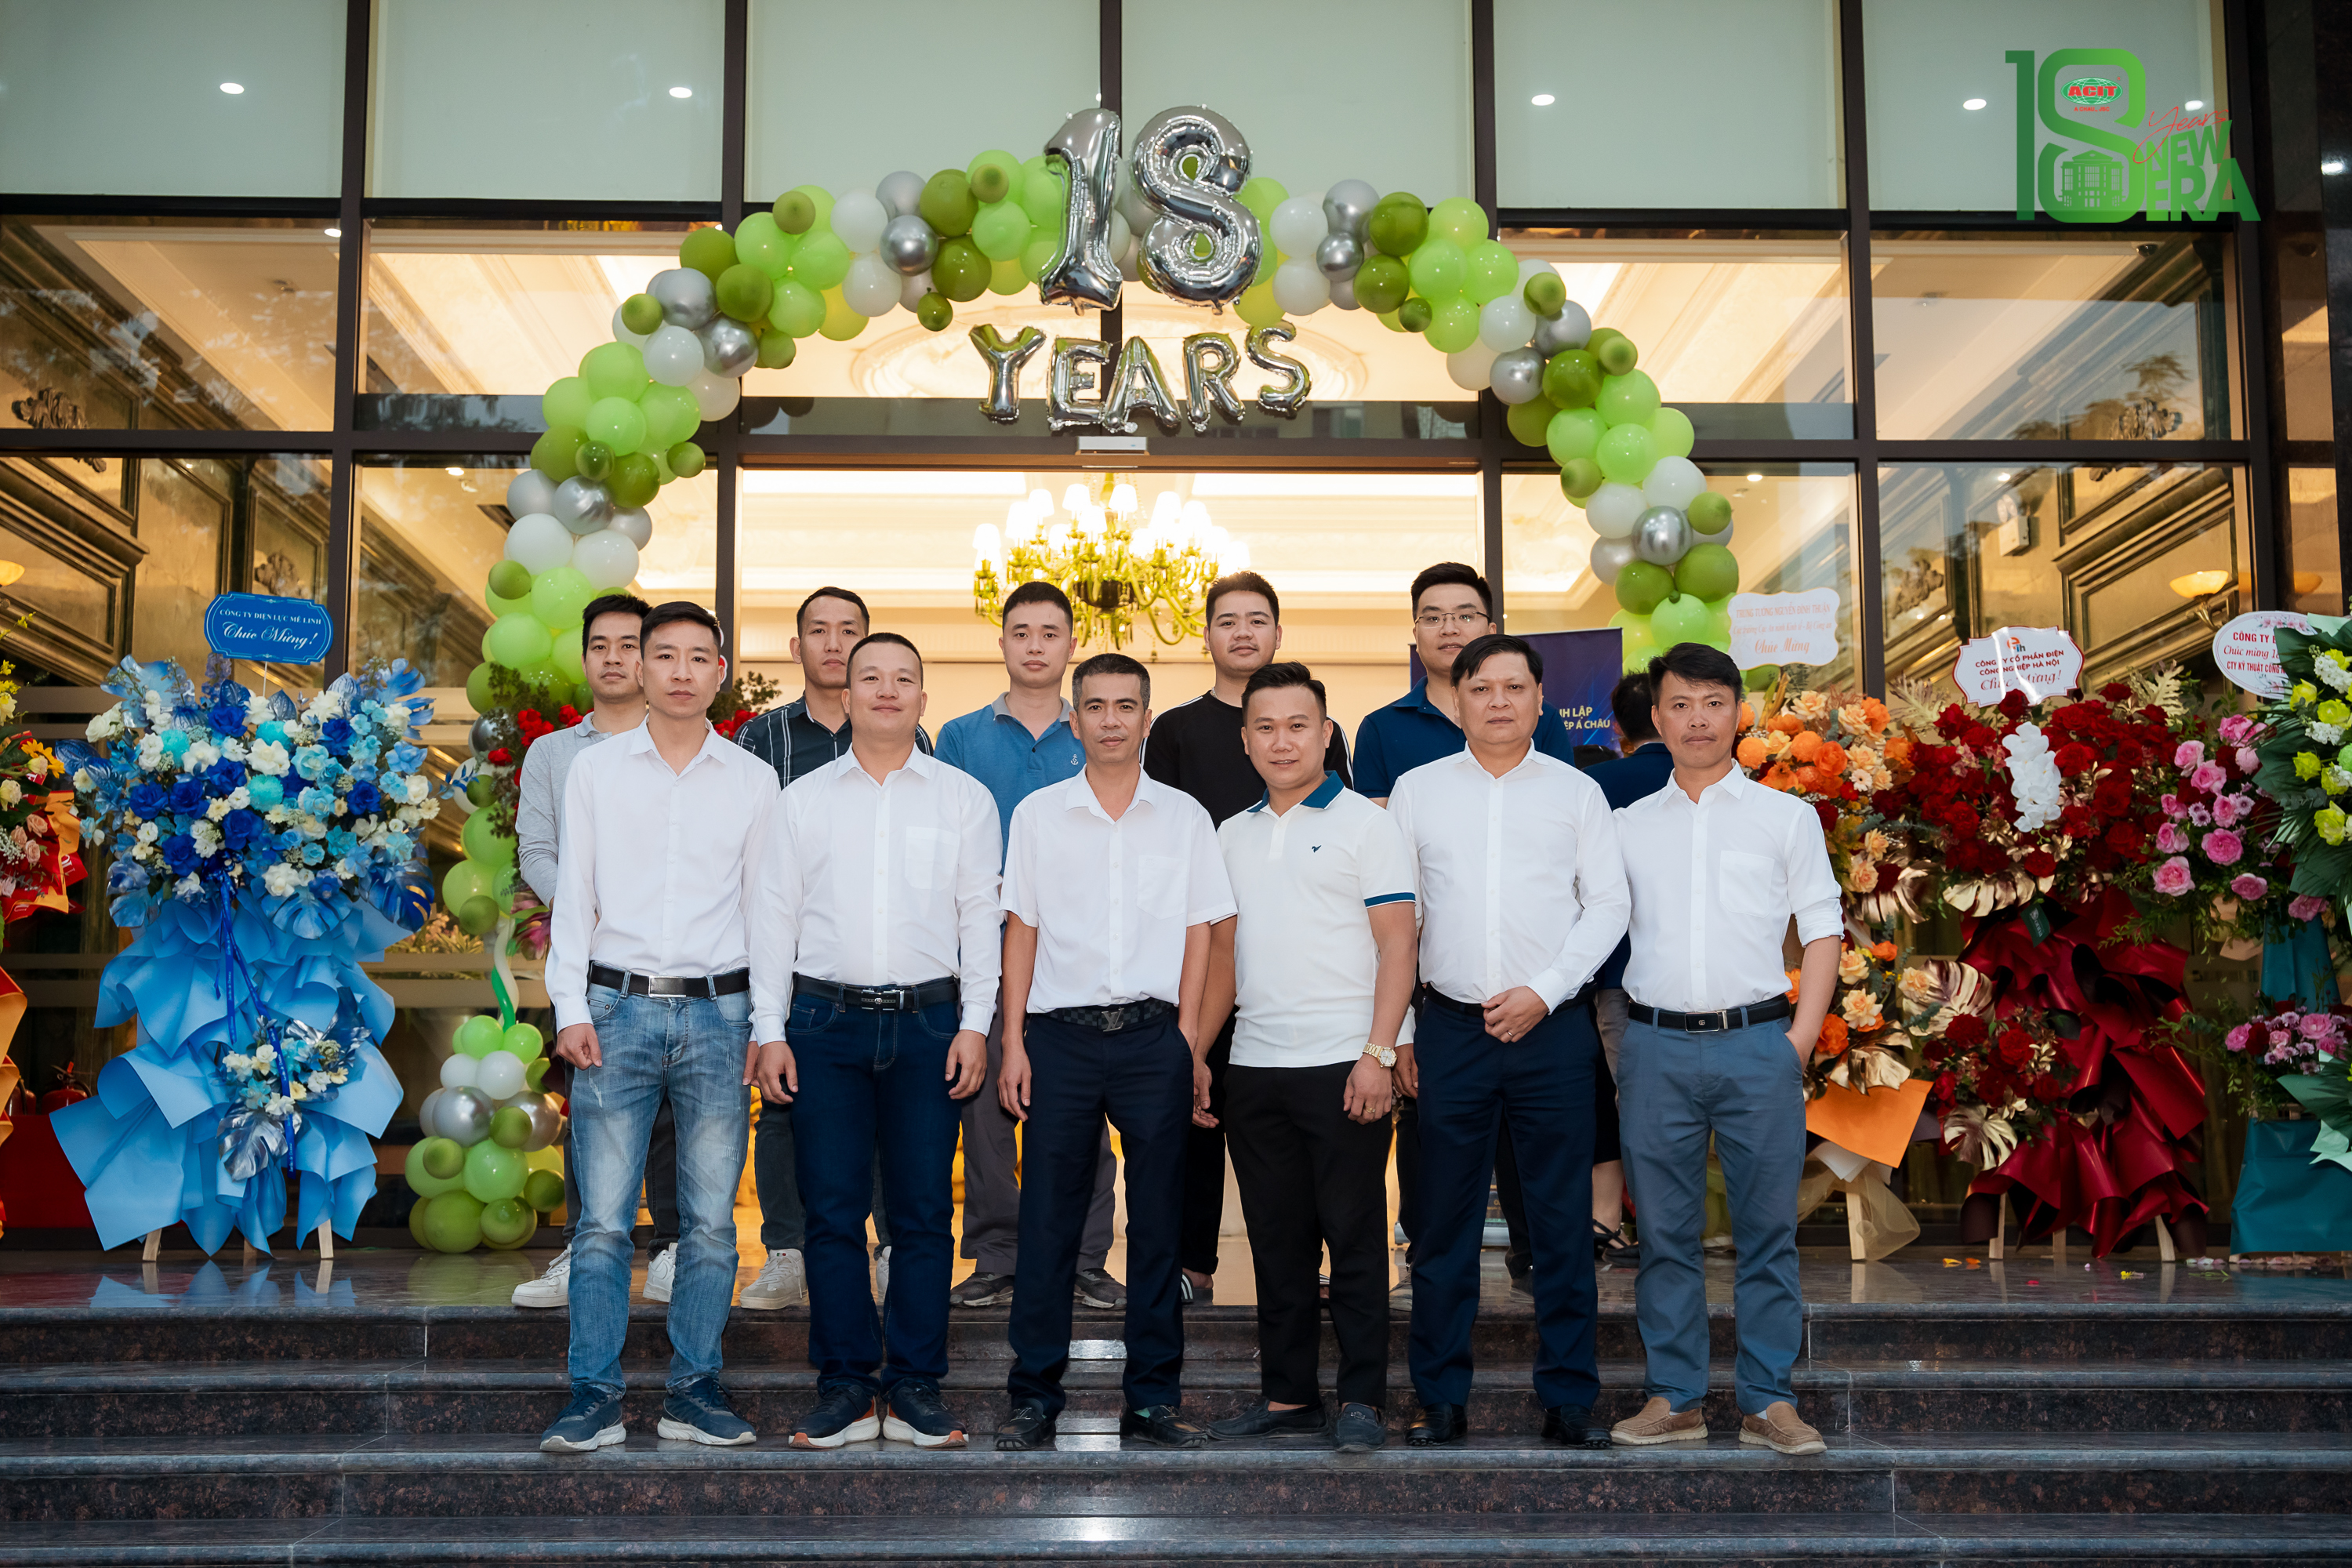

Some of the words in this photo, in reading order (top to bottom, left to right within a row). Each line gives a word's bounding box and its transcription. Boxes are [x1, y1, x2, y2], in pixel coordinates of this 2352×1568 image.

[1037, 105, 1262, 314] 18
[969, 321, 1312, 433] YEARS
[220, 608, 241, 617] CÔNG
[222, 621, 257, 640] Chúc
[2233, 630, 2257, 642] CÔNG
[2259, 633, 2270, 643] TY
[2223, 644, 2244, 655] Chúc
[1975, 659, 1997, 668] CÔNG
[2032, 660, 2044, 669] HÀ
[2227, 661, 2237, 670] CTY
[1980, 677, 2014, 691] Chc
[2016, 670, 2061, 685] ừng!
[1572, 705, 1593, 719] LẬP
[1584, 718, 1610, 729] CHÂU
